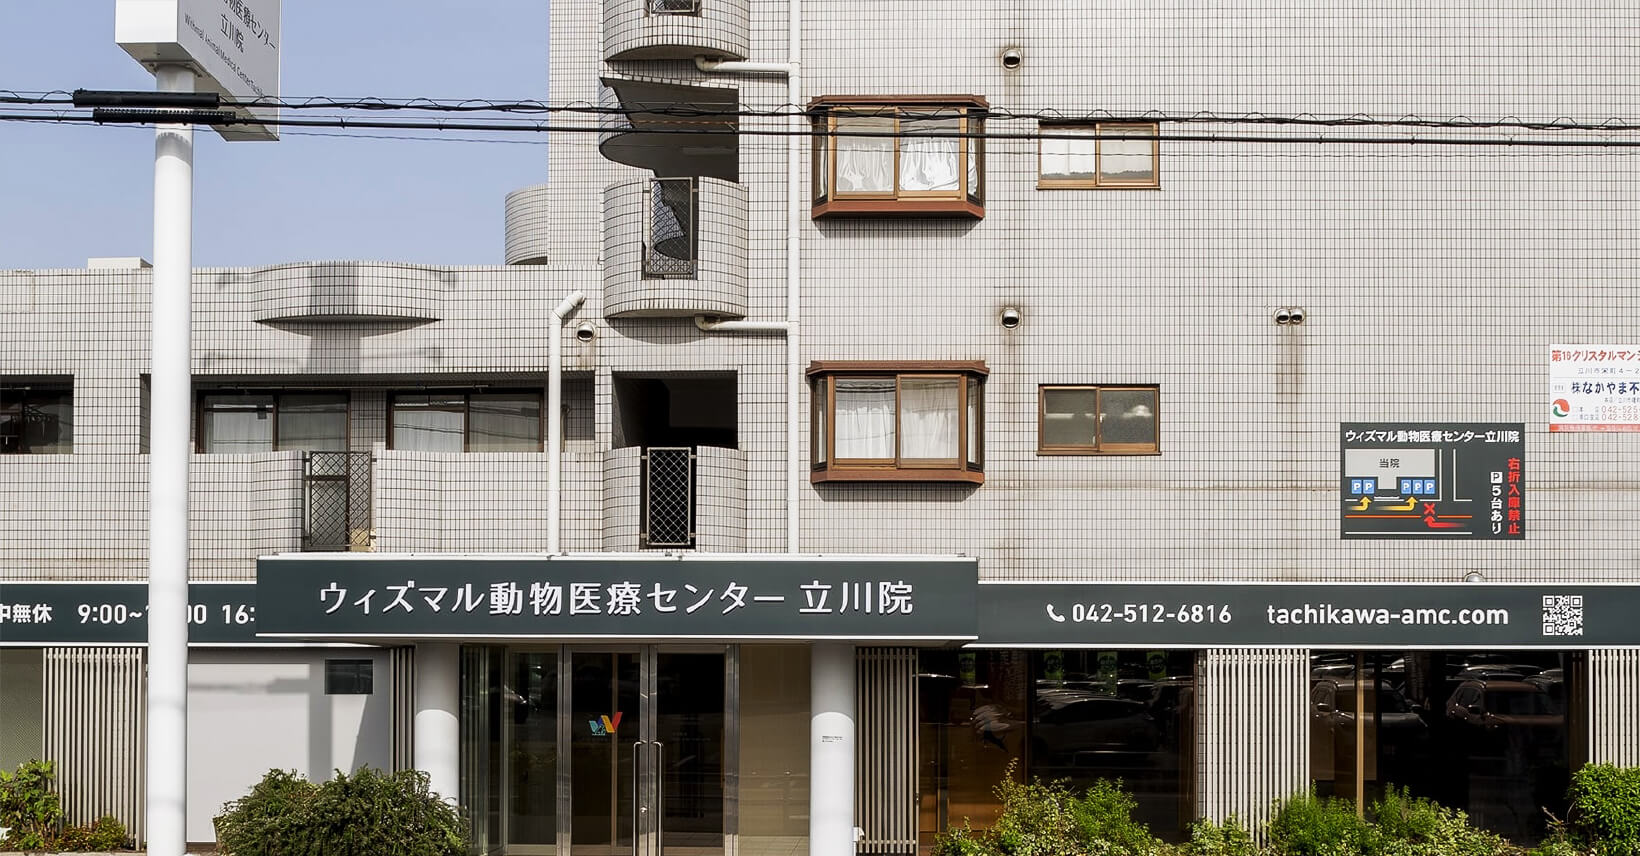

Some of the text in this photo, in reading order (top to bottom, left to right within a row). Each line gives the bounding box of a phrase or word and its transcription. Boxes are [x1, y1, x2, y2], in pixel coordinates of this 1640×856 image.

[220, 13, 244, 53] 立川院
[1345, 430, 1520, 443] ウィズマル動物医療センター立川院
[1379, 458, 1400, 468] 当院
[1508, 458, 1521, 534] 右折入庫禁止
[320, 580, 913, 615] ウィズマル動物医療センター 立川院
[1072, 603, 1509, 626] 042-512-6816 tachikawa-amc.com
